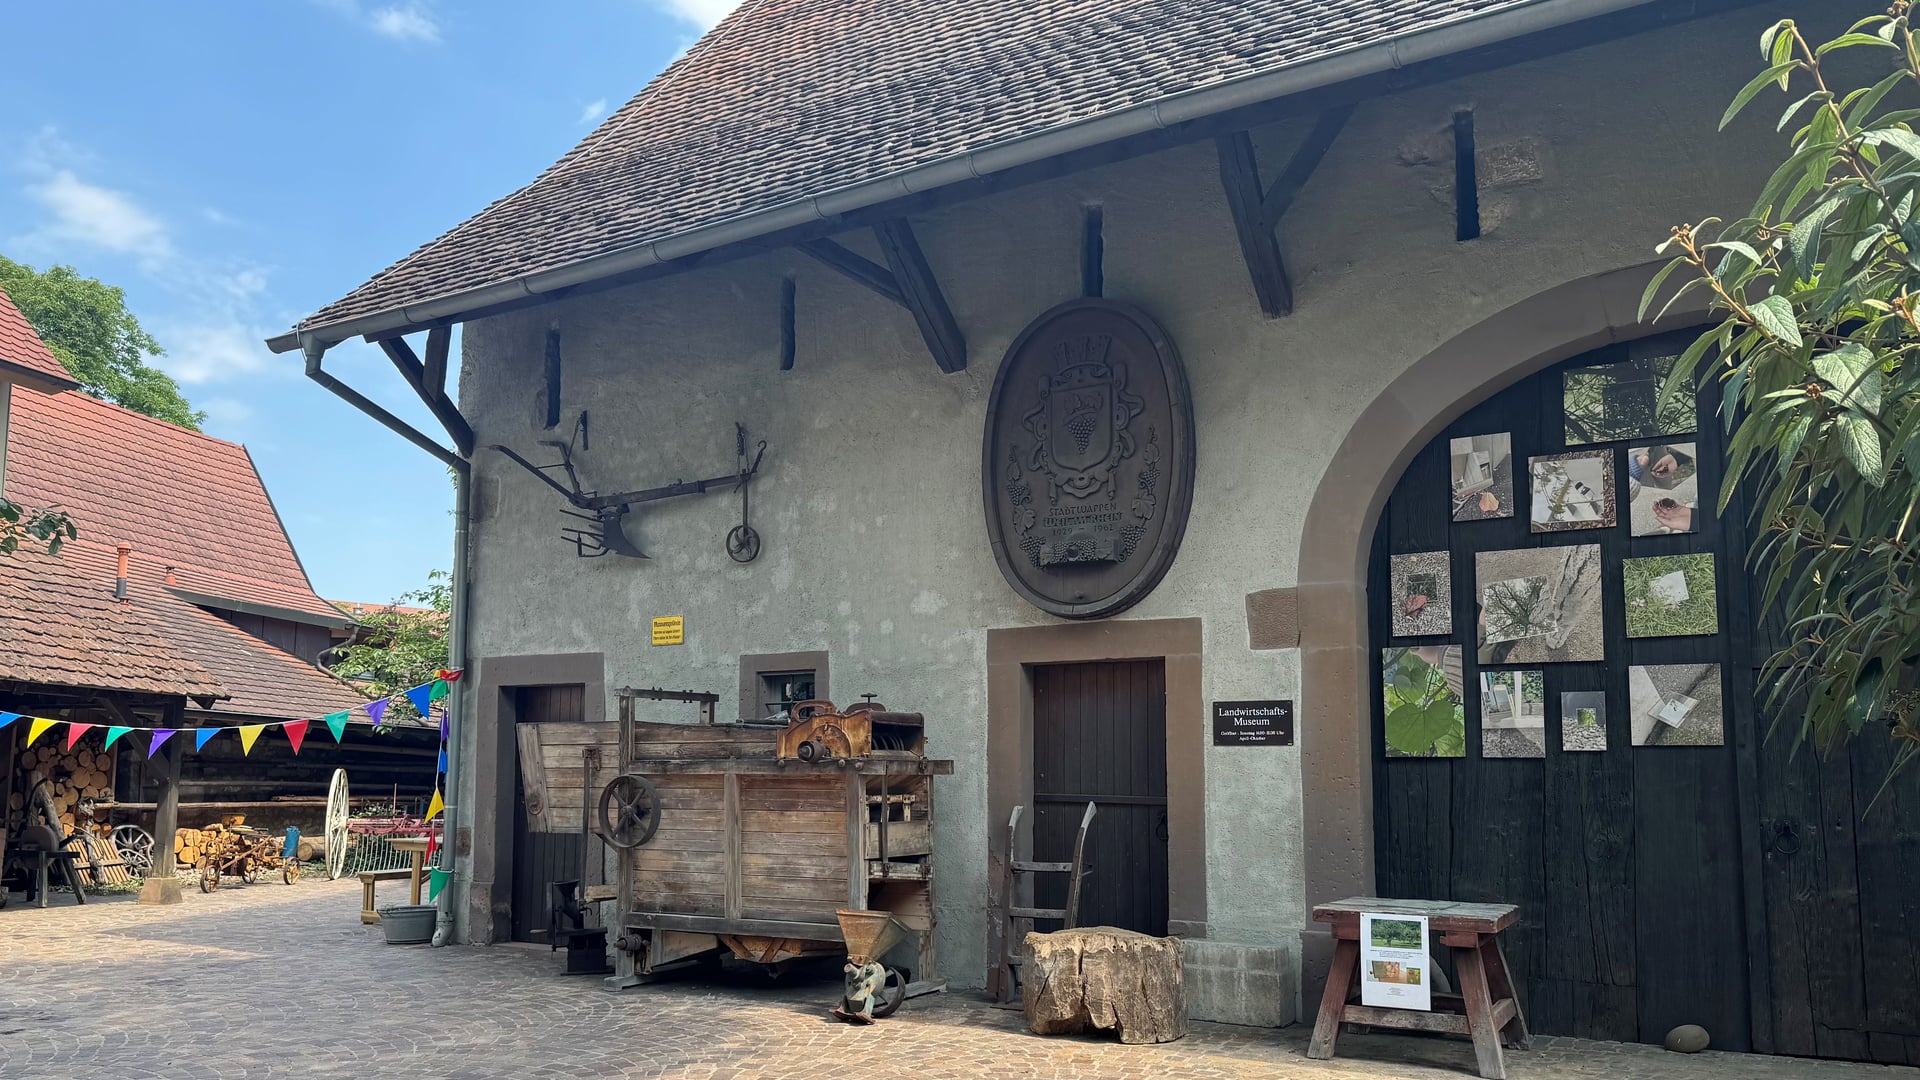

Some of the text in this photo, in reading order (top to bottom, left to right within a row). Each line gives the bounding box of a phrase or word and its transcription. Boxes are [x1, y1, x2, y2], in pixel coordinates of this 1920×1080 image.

[1049, 502, 1117, 517] STADTWAPPEN
[1094, 523, 1113, 533] 1962
[1219, 707, 1288, 716] Landwirtschafts-
[1234, 717, 1270, 726] Museum
